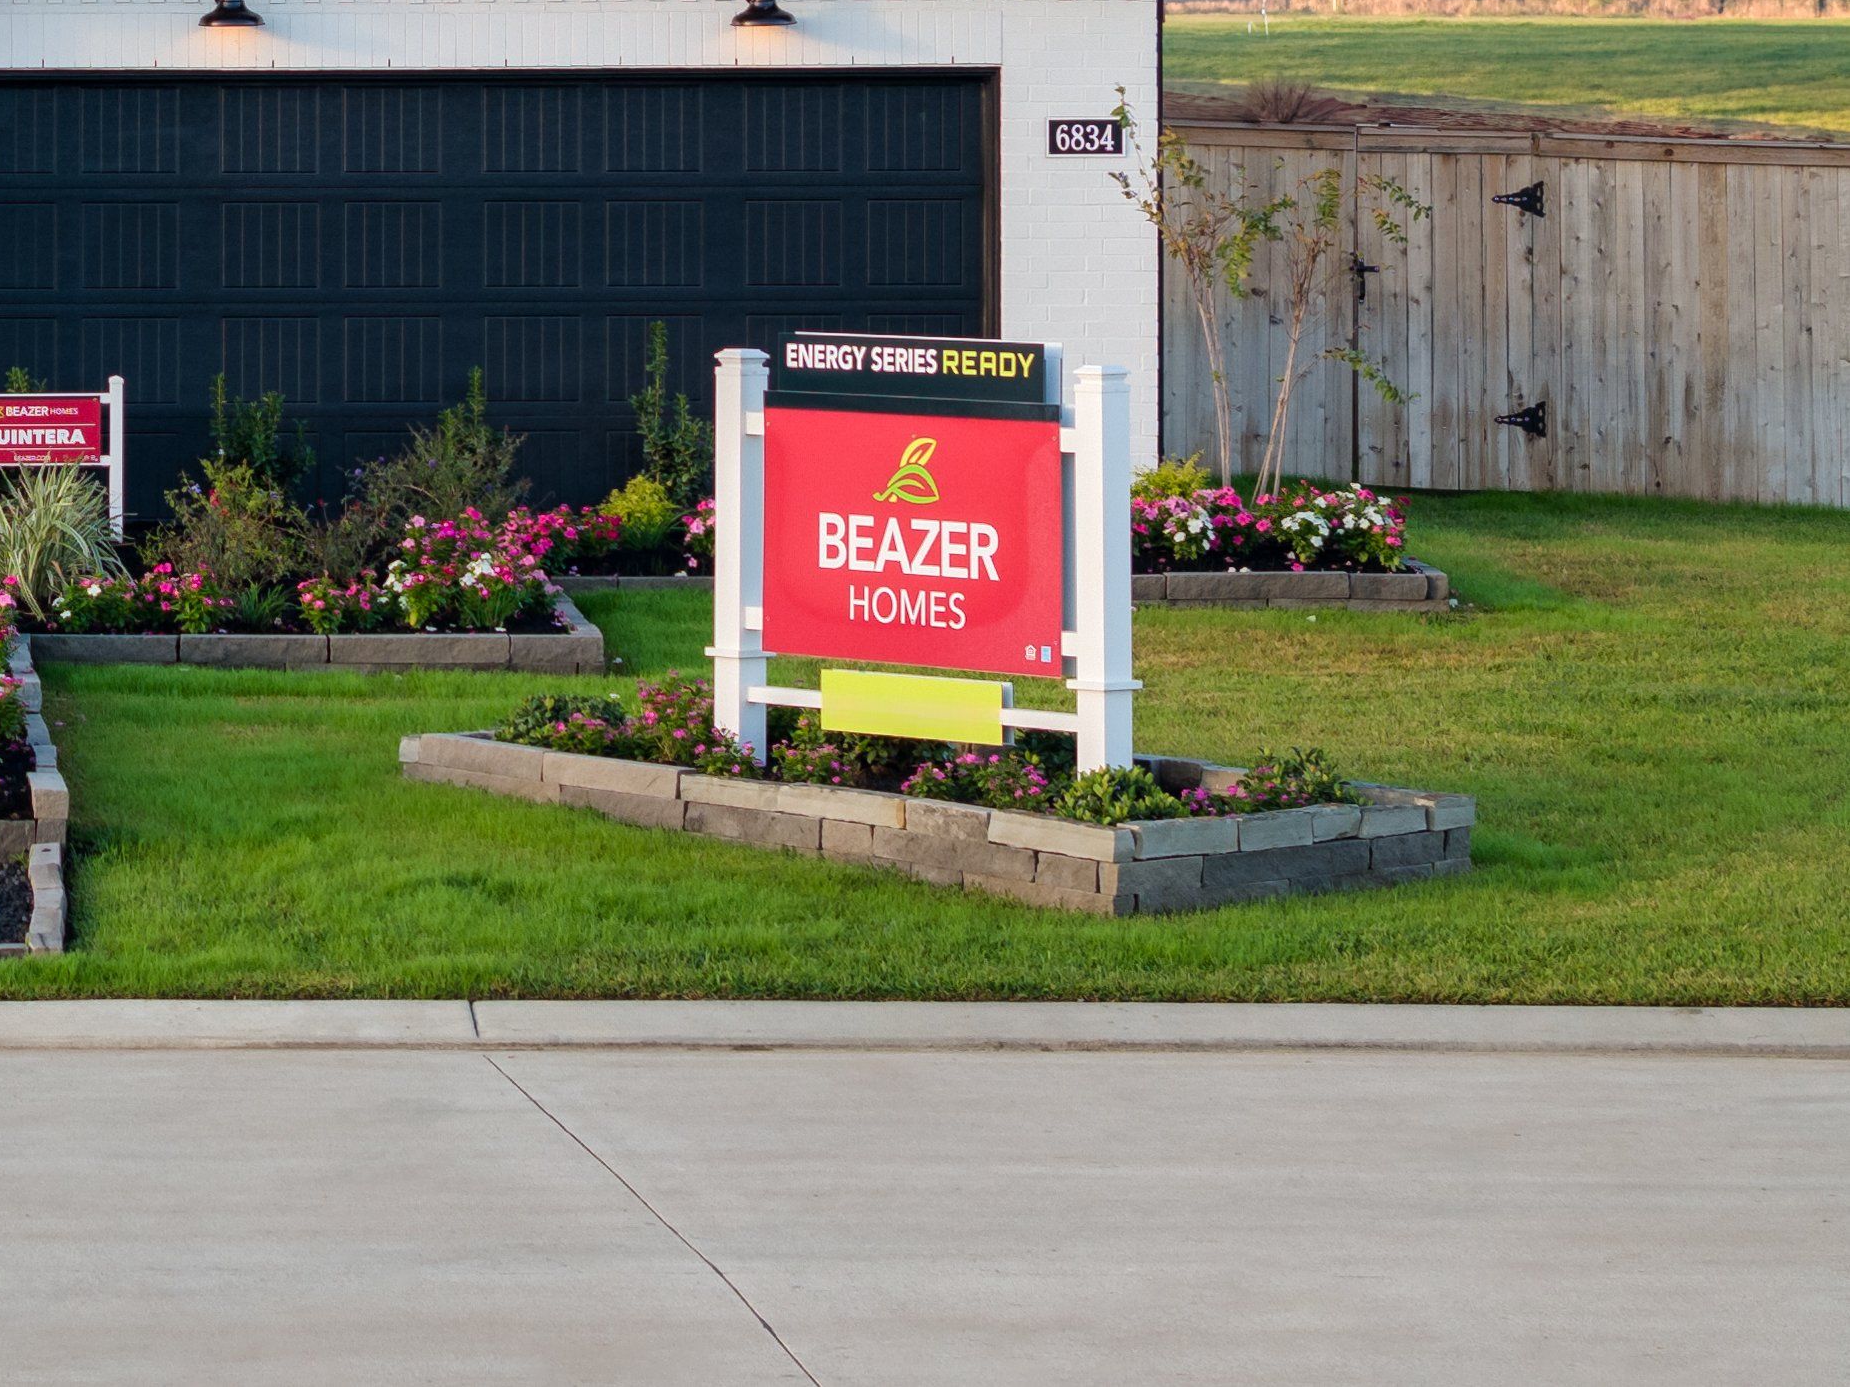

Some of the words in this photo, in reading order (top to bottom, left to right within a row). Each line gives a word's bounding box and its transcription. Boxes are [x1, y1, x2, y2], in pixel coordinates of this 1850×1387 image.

[1056, 124, 1114, 151] 6834
[786, 342, 867, 371] ENERGY
[870, 348, 938, 374] SERIES
[942, 349, 1036, 378] READY
[5, 406, 49, 417] BEAZER
[50, 407, 78, 415] HOMES
[818, 512, 1000, 581] BEAZER
[849, 585, 967, 630] HOMES
